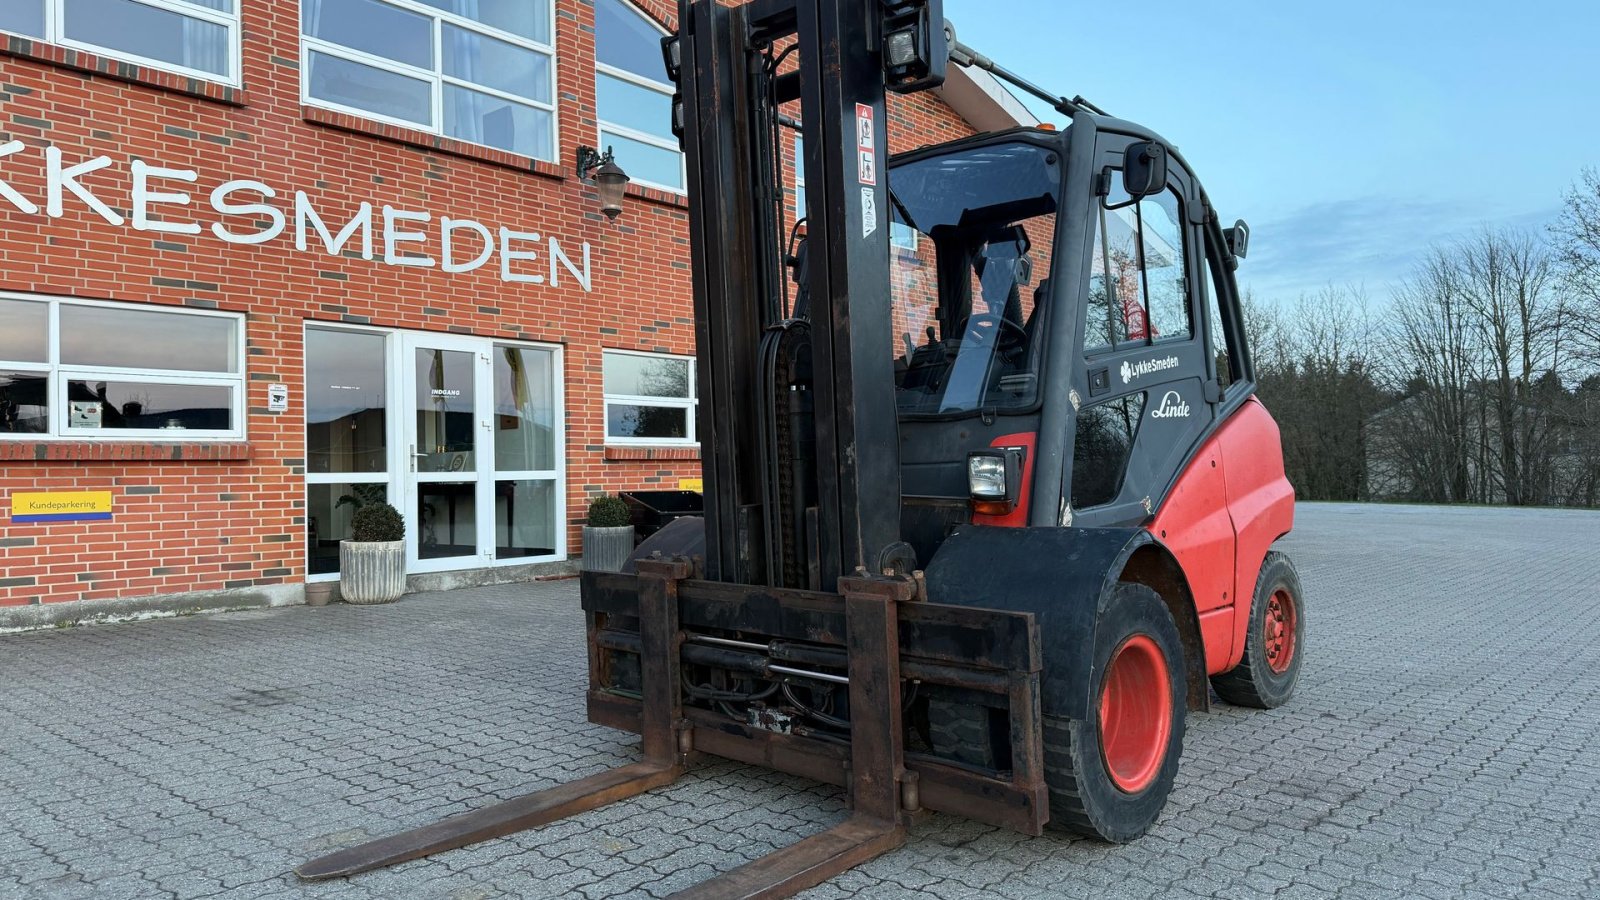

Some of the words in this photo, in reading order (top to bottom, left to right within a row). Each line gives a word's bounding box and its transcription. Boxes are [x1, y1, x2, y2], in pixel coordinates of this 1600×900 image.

[1131, 355, 1179, 379] LykkeSmeden
[1151, 390, 1191, 418] Linde
[29, 501, 96, 511] Kundeparkering
